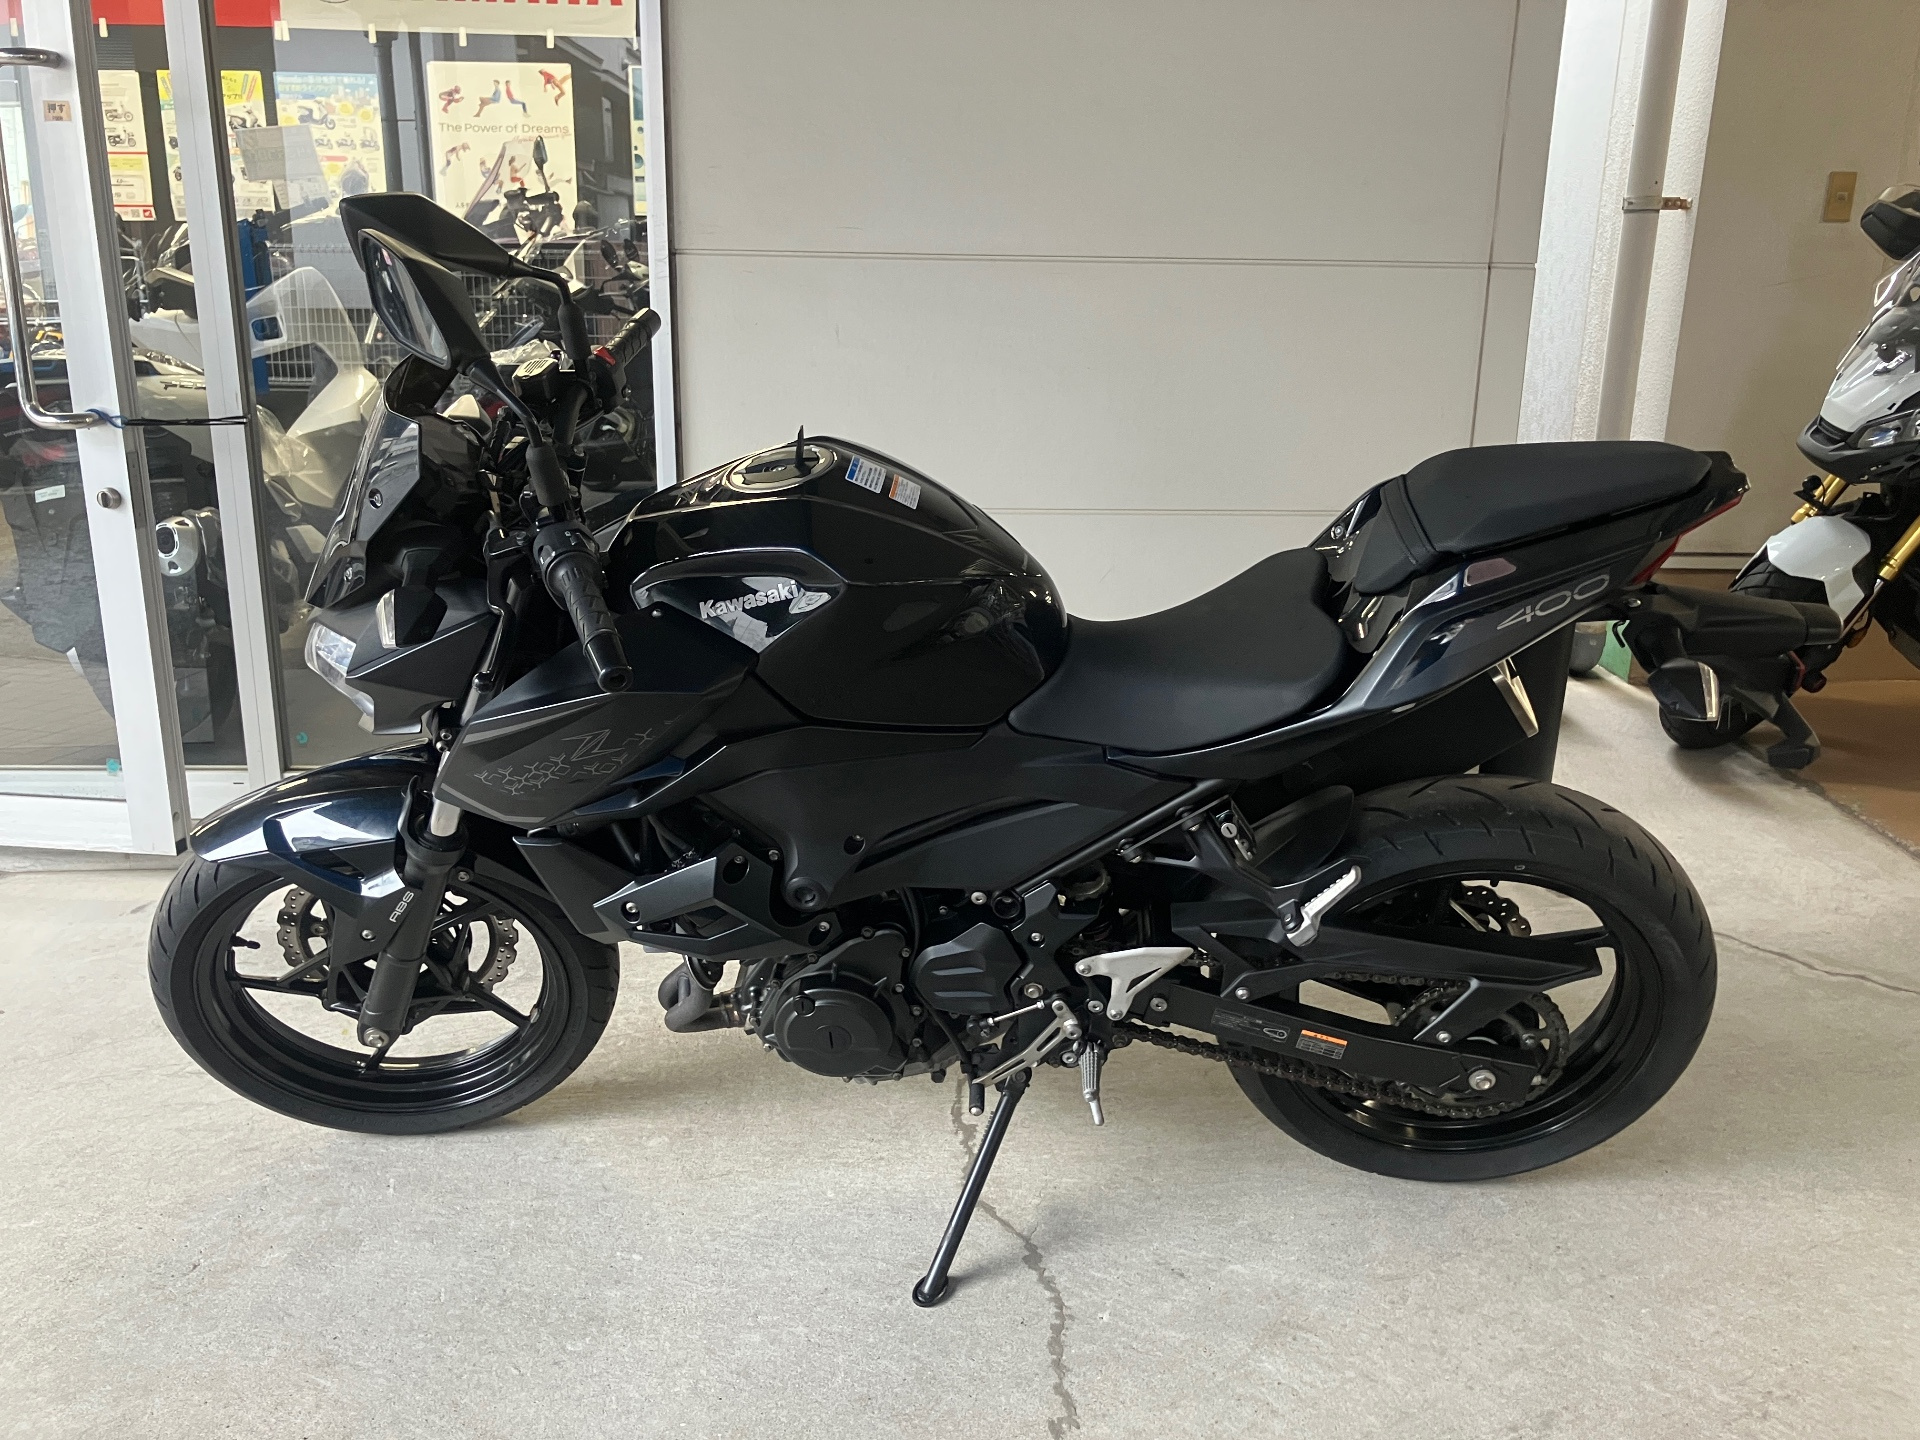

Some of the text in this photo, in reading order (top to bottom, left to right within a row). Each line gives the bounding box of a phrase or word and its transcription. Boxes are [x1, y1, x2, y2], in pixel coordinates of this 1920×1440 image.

[47, 103, 66, 114] 押す
[439, 122, 570, 134] The Power of Dreams
[699, 580, 799, 619] Kawasaki
[1497, 574, 1610, 630] 400
[389, 891, 414, 923] ABS
